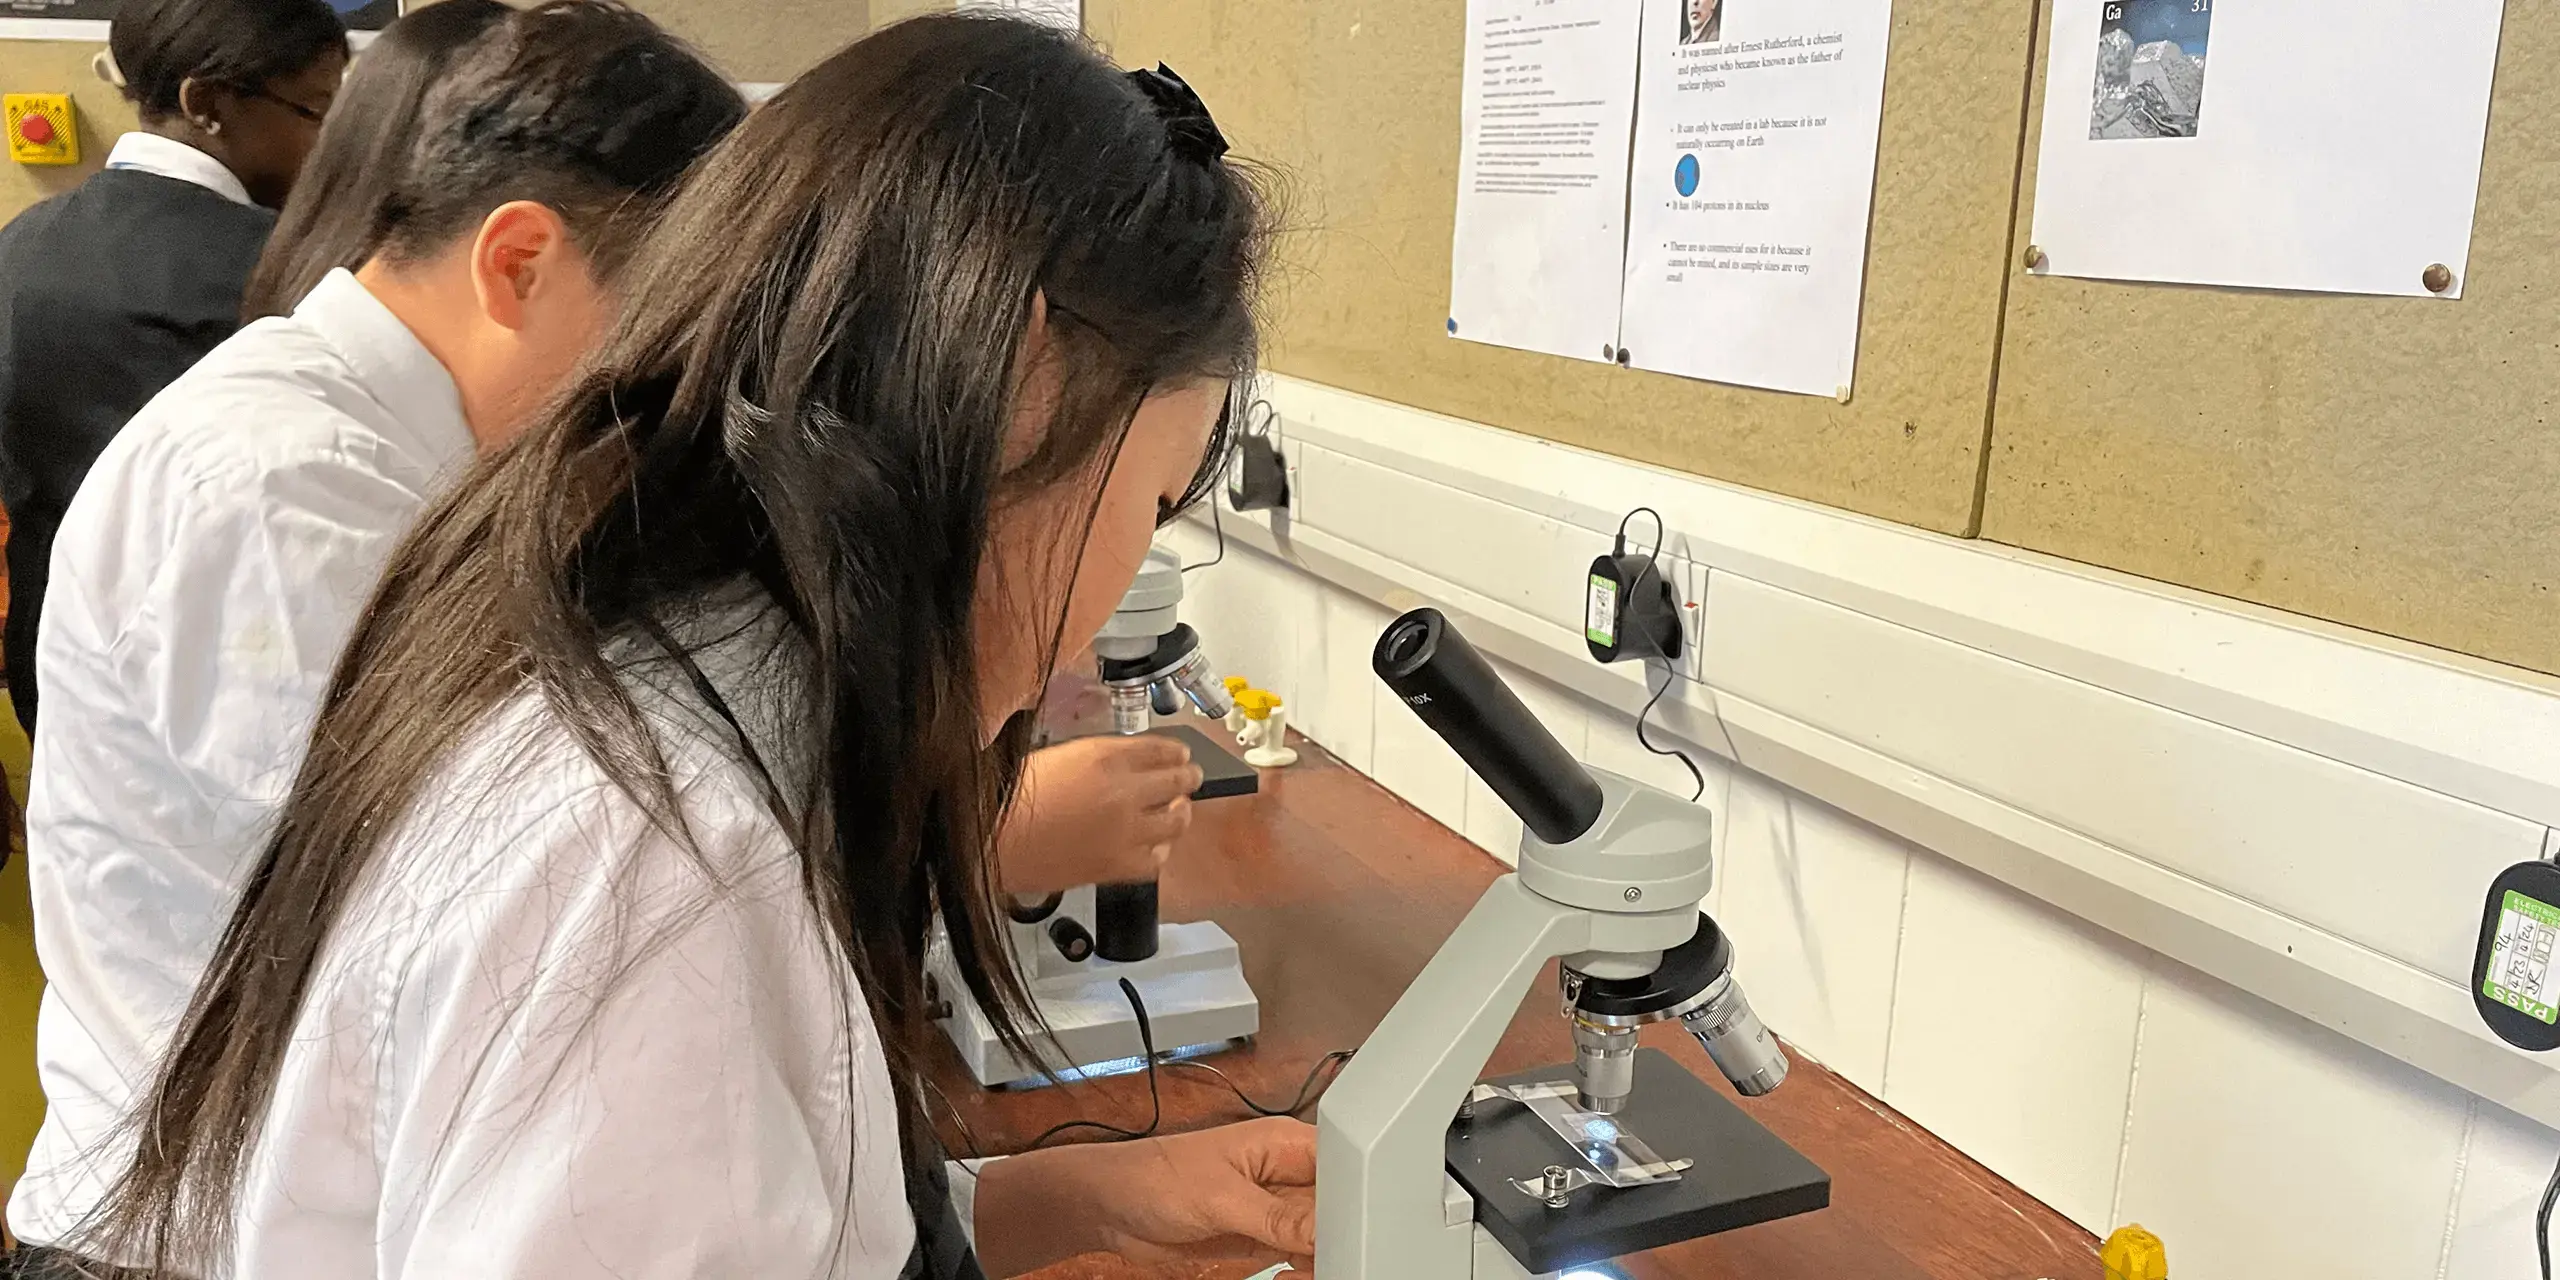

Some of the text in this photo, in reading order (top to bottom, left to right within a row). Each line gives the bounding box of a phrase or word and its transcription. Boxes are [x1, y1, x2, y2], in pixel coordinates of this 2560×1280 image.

[2106, 5, 2122, 20] Ga
[2191, 0, 2208, 12] 31
[1724, 42, 1739, 54] after
[1741, 41, 1762, 52] Ernest
[1813, 31, 1842, 44] chemist
[1678, 49, 1843, 77] and physicist who became known as the father of
[1678, 78, 1725, 92] nuclear physics
[24, 99, 49, 112] GAS
[1677, 123, 1682, 133] It
[1684, 125, 1694, 133] can
[1696, 121, 1709, 134] only
[1711, 121, 1719, 131] be
[1720, 119, 1744, 131] created
[1746, 119, 1752, 129] in
[1759, 118, 1769, 129] lab
[1771, 118, 1798, 128] because
[1800, 116, 1806, 127] it
[1807, 115, 1813, 127] is
[1815, 117, 1827, 126] not
[1676, 138, 1702, 151] naturally
[1737, 139, 1745, 147] on
[1747, 135, 1765, 147] Earth
[1679, 200, 1689, 210] has
[1745, 199, 1770, 210] nucleus
[1707, 243, 1743, 253] commercial
[1760, 243, 1769, 254] for
[1770, 244, 1776, 255] it
[1777, 244, 1805, 255] because
[1805, 246, 1811, 255] it
[1689, 257, 1696, 267] be
[1718, 259, 1731, 269] and
[1741, 260, 1763, 273] sample
[1764, 260, 1780, 271] sizes
[1781, 264, 1793, 272] are
[1794, 264, 1810, 275] very
[1666, 272, 1683, 282] small
[2495, 933, 2512, 951] 94
[2493, 986, 2547, 1020] PASS
